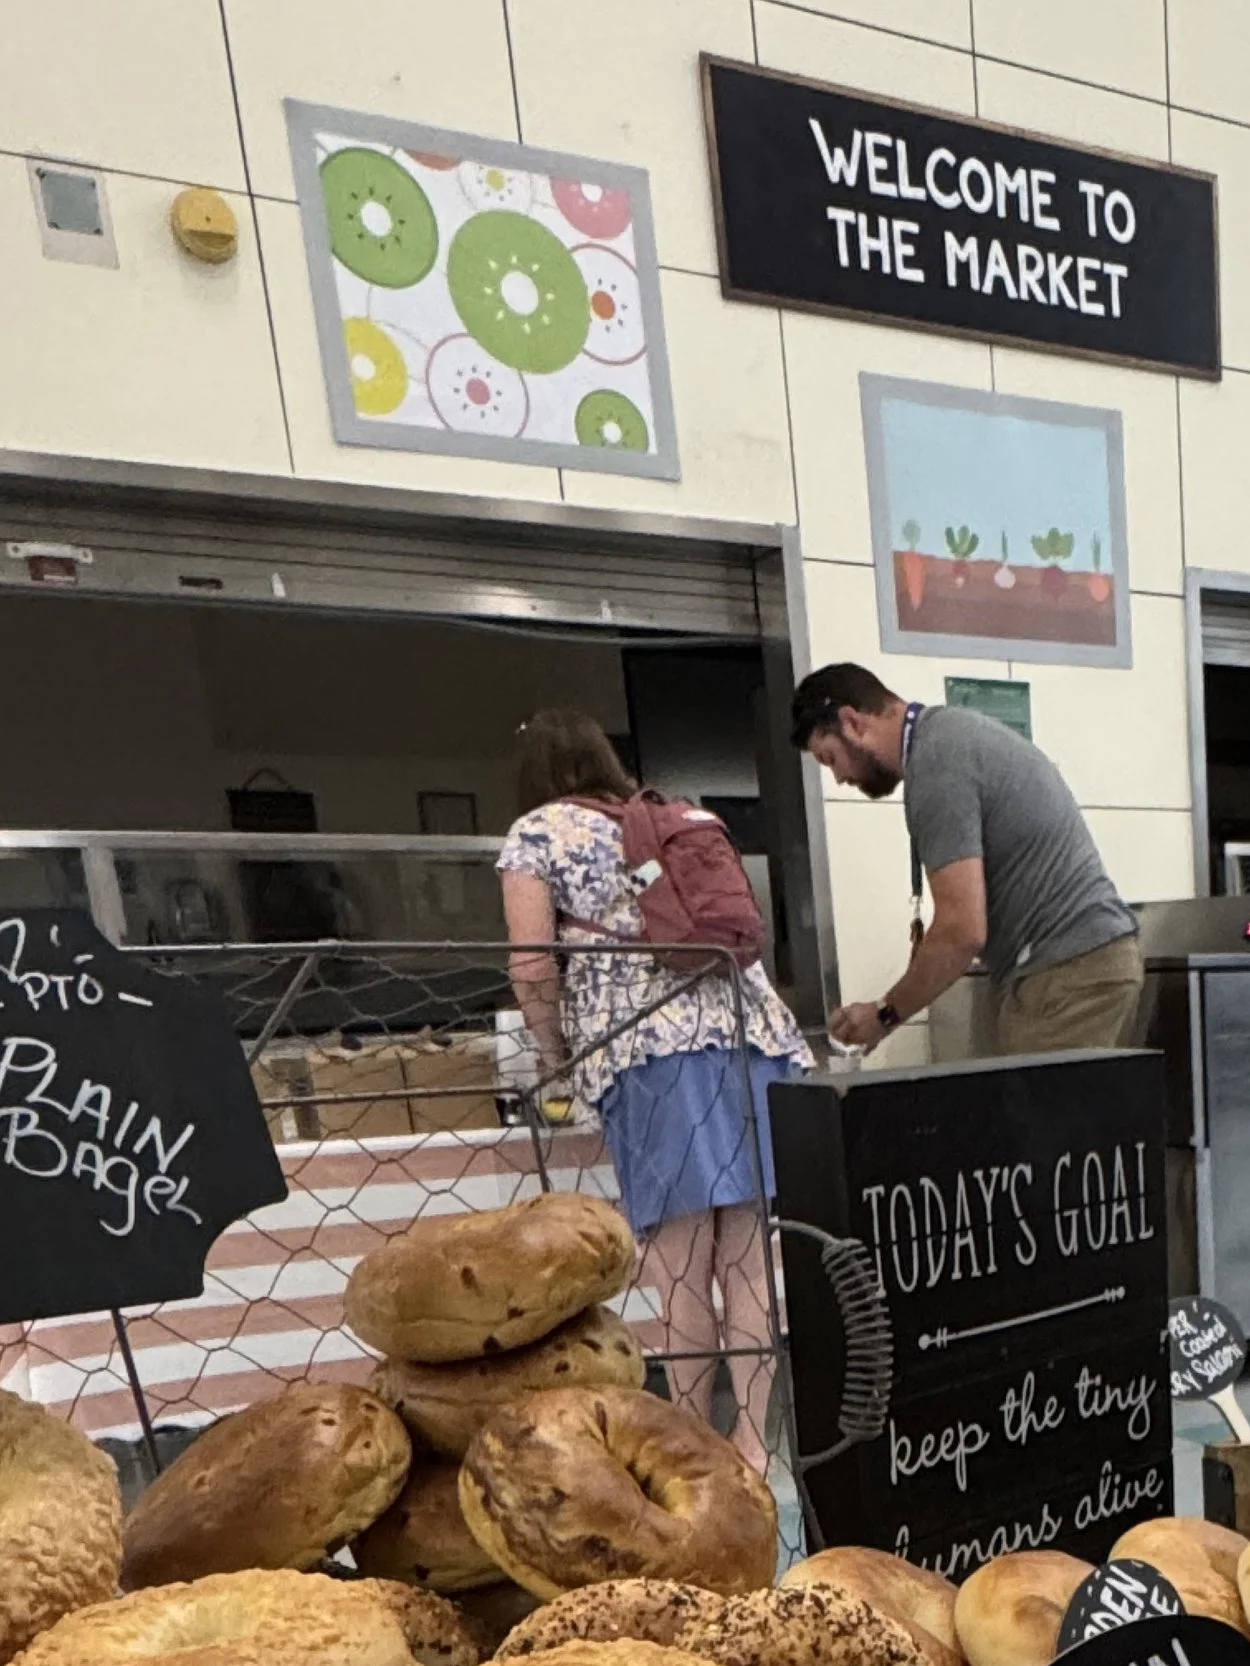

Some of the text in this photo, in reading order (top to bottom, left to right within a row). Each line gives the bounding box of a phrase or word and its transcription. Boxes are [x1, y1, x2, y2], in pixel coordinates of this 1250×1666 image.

[807, 117, 1137, 245] WELCOME TO
[826, 206, 1129, 319] THE MARKET
[0, 1037, 195, 1174] PLAIN
[862, 1141, 1155, 1299] TODAY'S GOAL
[890, 1365, 1157, 1492] keep the tiny
